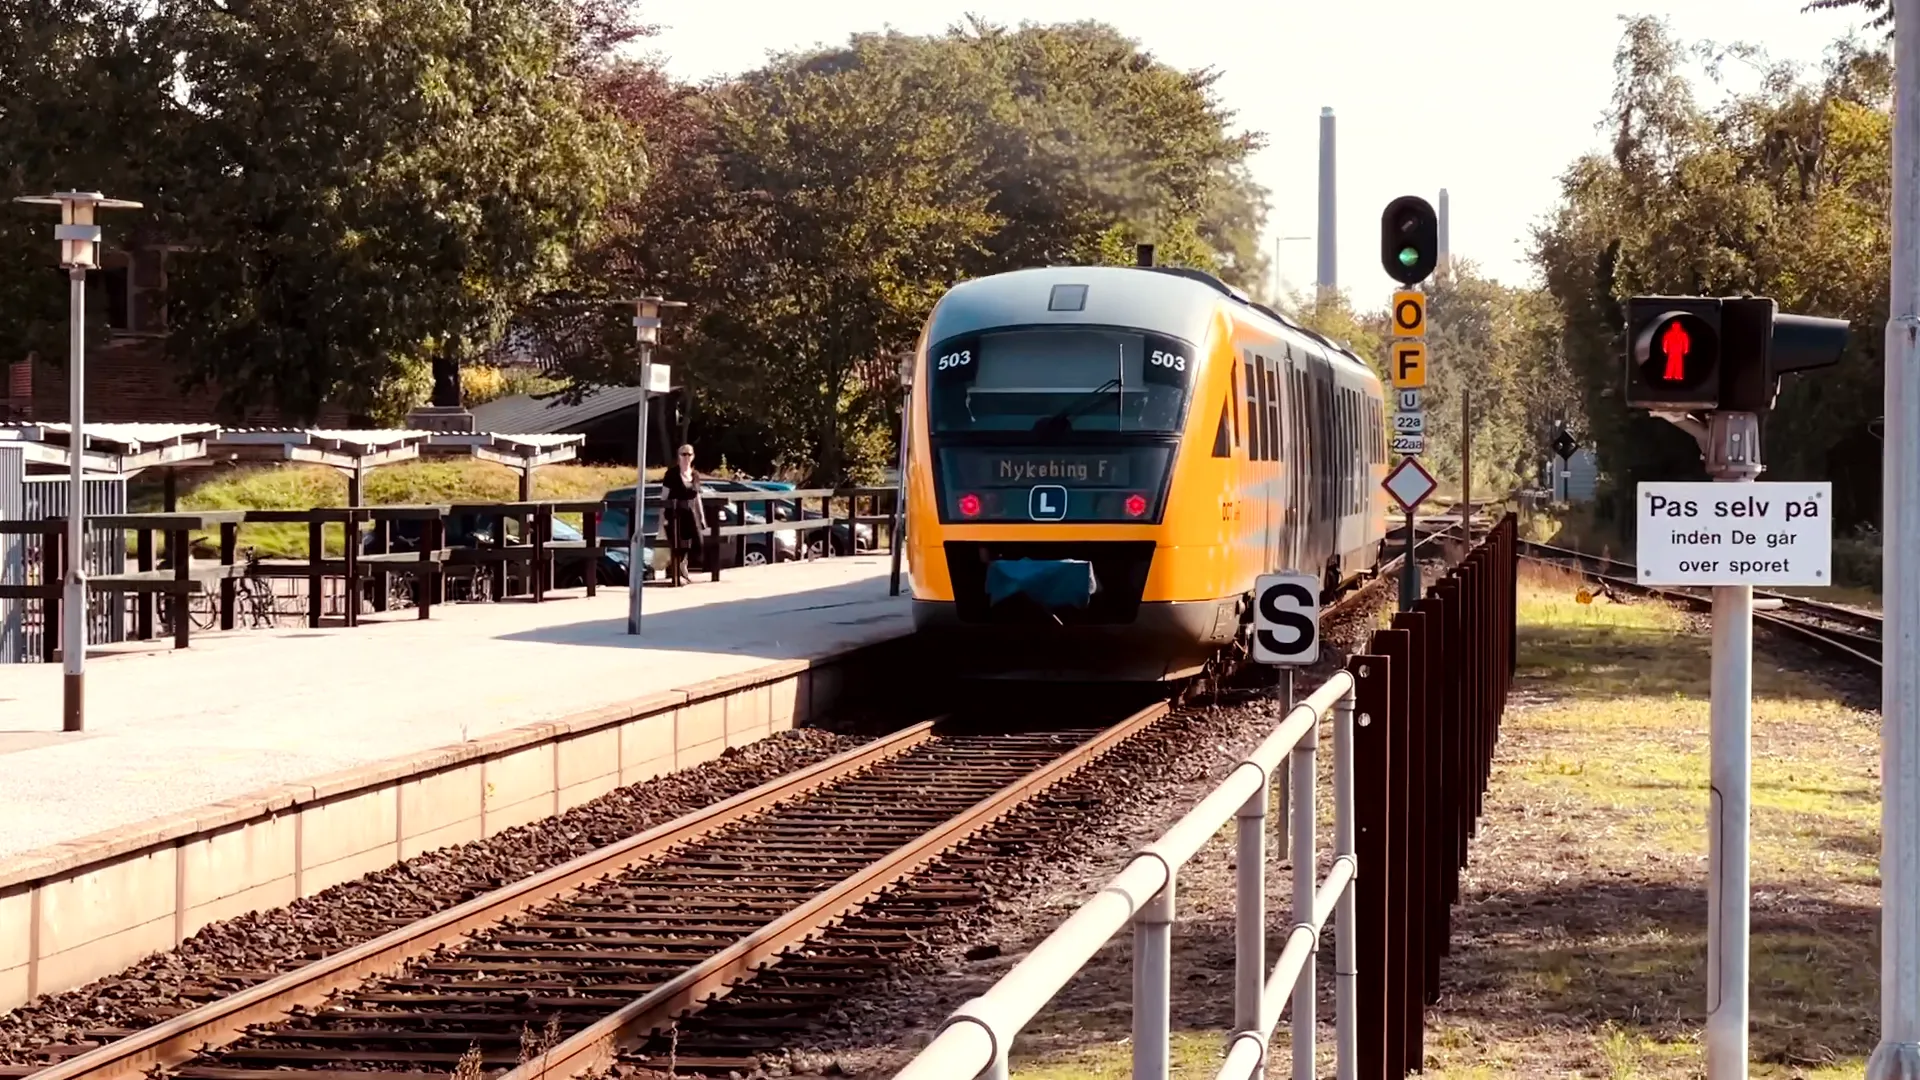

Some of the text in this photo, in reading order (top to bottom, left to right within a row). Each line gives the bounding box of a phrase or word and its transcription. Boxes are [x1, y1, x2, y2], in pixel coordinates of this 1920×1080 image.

[1396, 299, 1422, 330] O
[938, 350, 971, 370] 503
[1151, 350, 1186, 371] 503
[1399, 350, 1420, 380] F
[1404, 393, 1416, 407] U
[1397, 417, 1421, 428] 22a
[1040, 492, 1056, 512] L
[1650, 495, 1819, 522] Pas selv på
[1671, 530, 1721, 545] inden
[1731, 530, 1757, 545] De
[1679, 558, 1790, 575] over sporet
[1257, 583, 1315, 656] S
